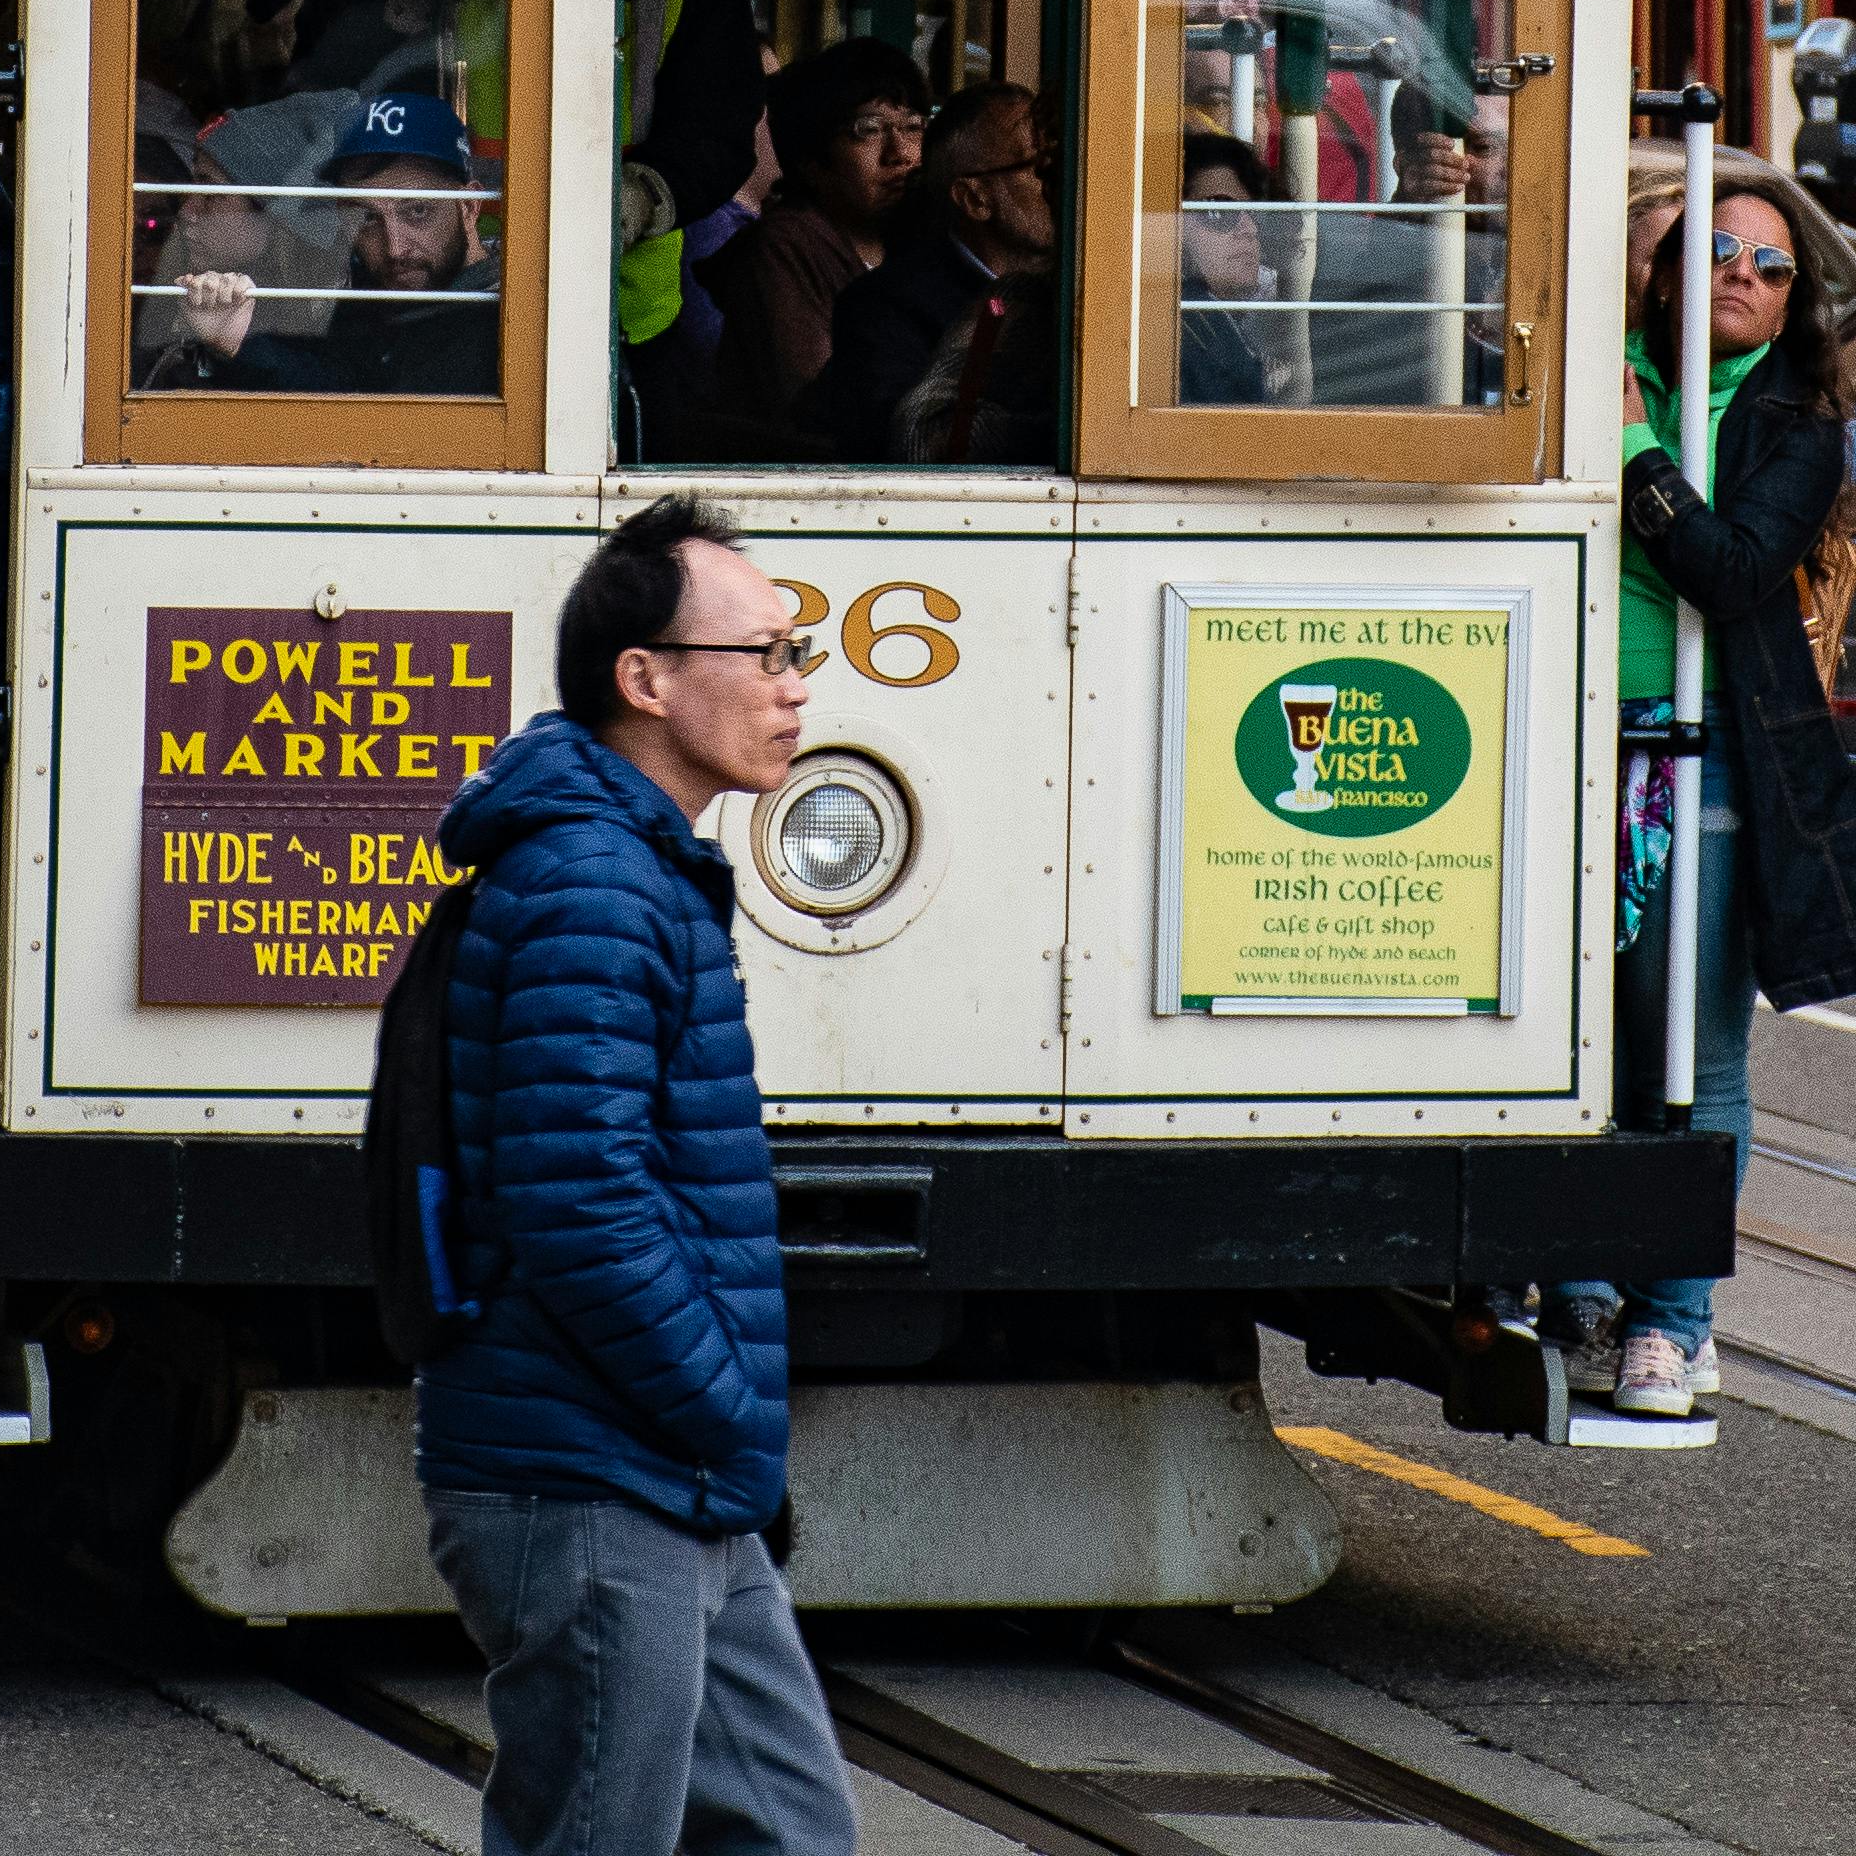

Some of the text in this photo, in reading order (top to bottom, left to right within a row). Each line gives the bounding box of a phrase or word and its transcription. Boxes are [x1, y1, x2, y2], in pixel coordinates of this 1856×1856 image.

[366, 99, 406, 136] KC
[1401, 618, 1453, 646] the
[169, 639, 493, 688] POWELL
[252, 691, 411, 726] AND
[1338, 688, 1384, 712] the
[159, 731, 495, 778] MARKET
[163, 831, 476, 886] HYDE AND BEAC
[1206, 847, 1266, 868] home
[1271, 849, 1296, 870] of
[1302, 849, 1336, 868] the
[1316, 917, 1328, 935] &
[1381, 916, 1435, 938] shop
[254, 943, 394, 977] WHARF
